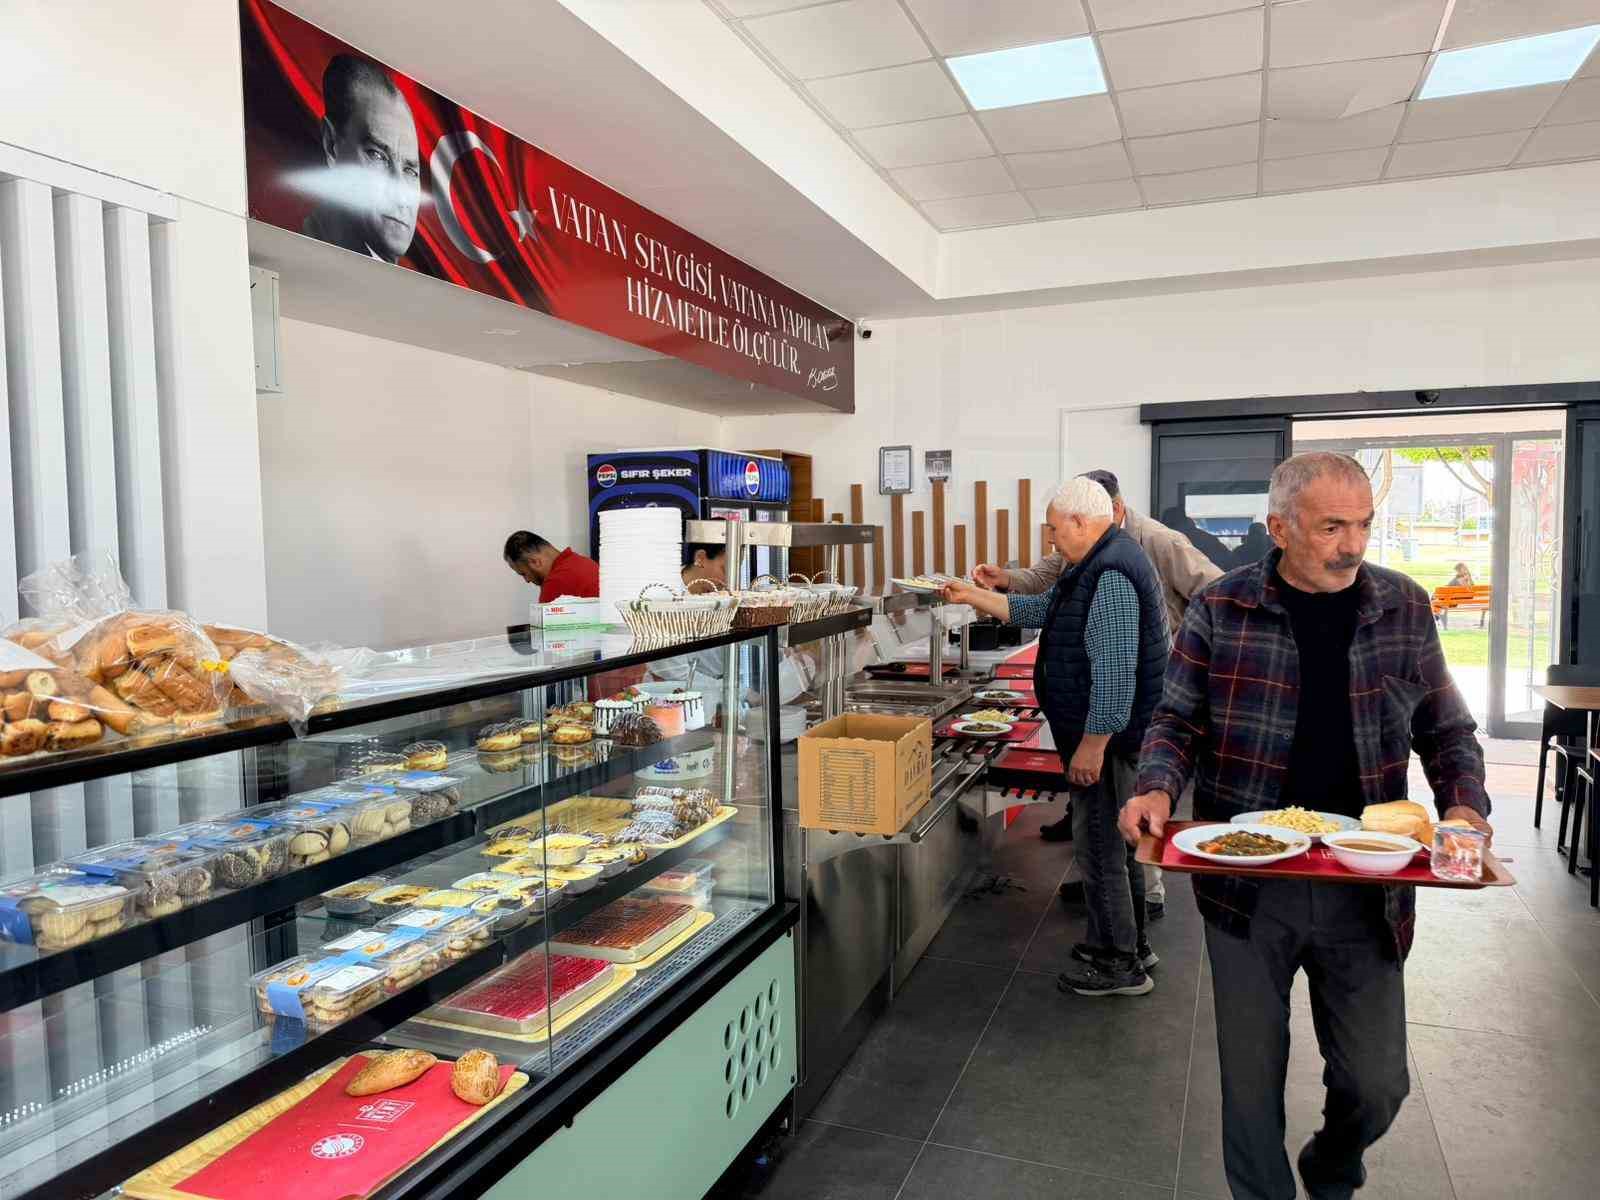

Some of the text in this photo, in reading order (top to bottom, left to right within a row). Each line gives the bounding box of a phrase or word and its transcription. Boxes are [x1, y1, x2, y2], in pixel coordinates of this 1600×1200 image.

[548, 186, 831, 352] VATAN SEVGİSİ, VATANA YAPILAN
[626, 276, 801, 375] HİZMETLE ÖLÇÜLÜR.
[620, 468, 692, 480] SIFIR ŞEKER
